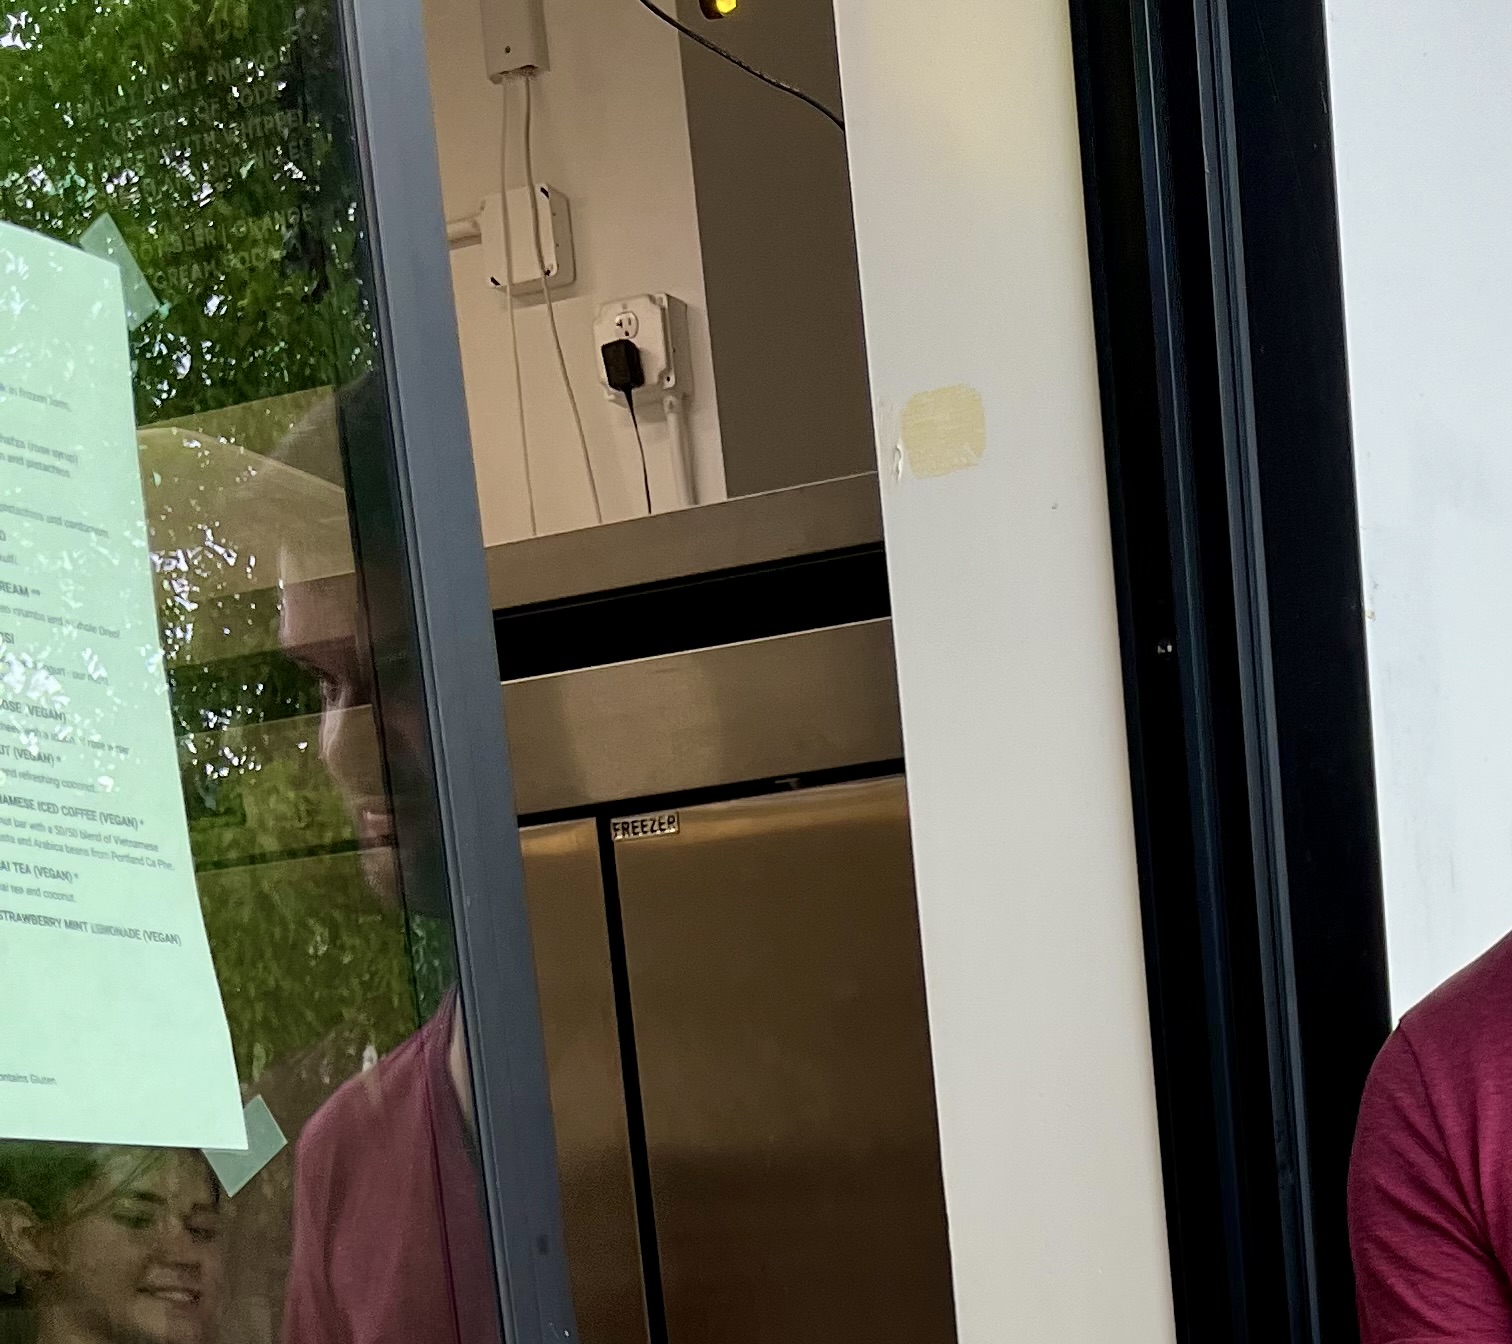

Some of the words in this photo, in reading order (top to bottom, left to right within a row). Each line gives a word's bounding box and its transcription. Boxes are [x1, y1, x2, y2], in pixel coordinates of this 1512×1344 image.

[37, 801, 60, 814] ICED
[61, 806, 98, 822] COFFEE
[612, 815, 677, 838] FREEZER
[12, 861, 31, 875] TEA
[64, 918, 88, 933] MINT
